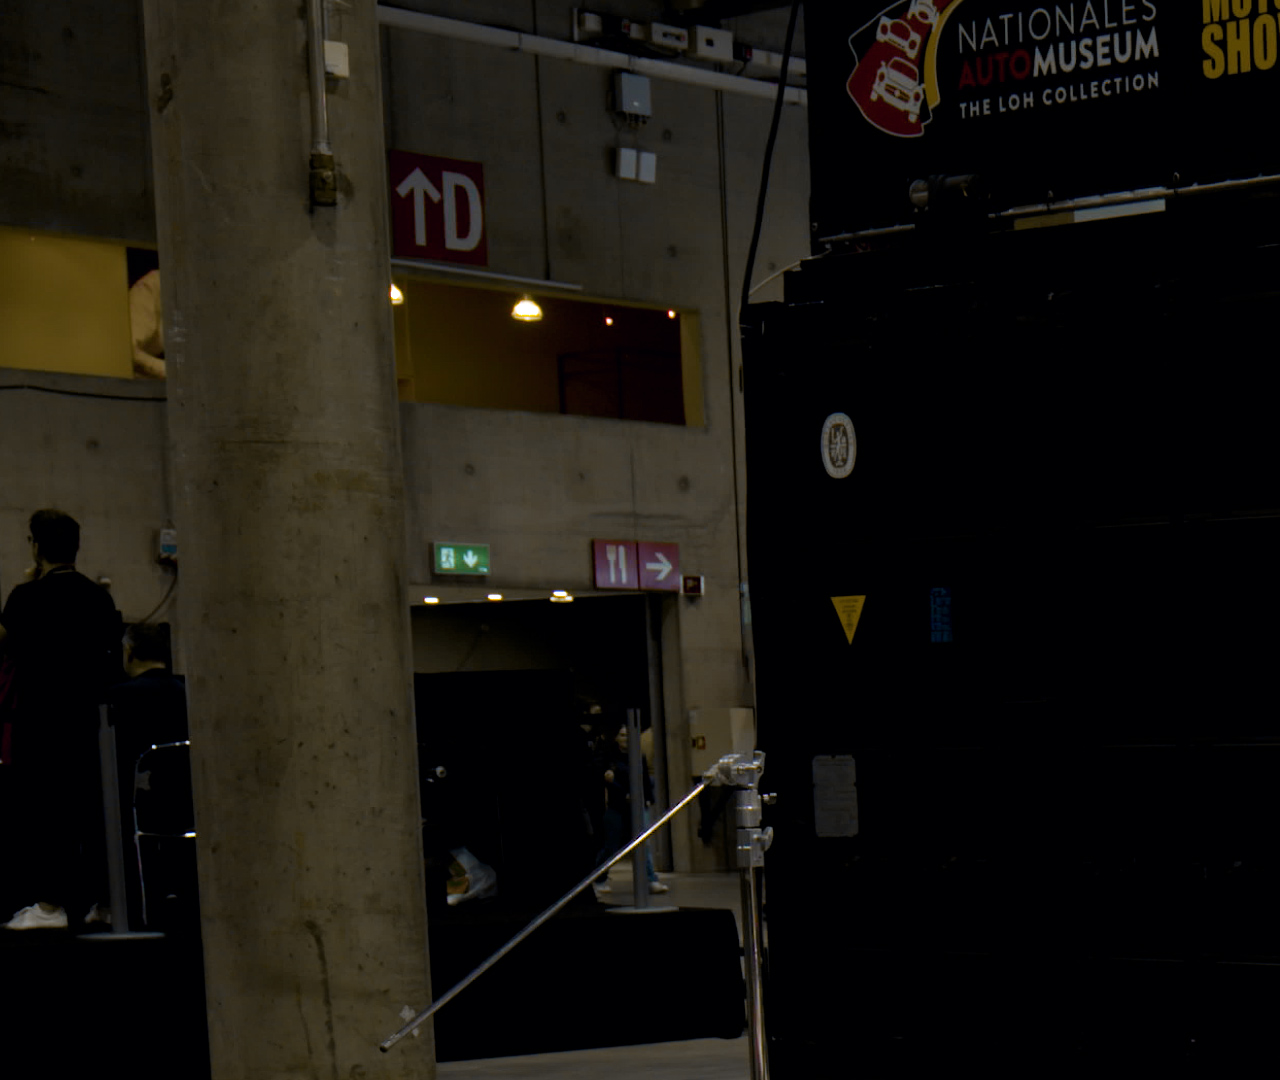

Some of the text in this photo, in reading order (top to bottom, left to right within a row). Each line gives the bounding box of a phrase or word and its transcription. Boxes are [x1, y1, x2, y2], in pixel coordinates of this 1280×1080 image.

[958, 0, 1157, 53] NATIONALES
[958, 26, 1160, 90] AUTOMUSEUM
[959, 71, 1160, 119] THE LOH COLLECTION
[443, 171, 484, 252] D
